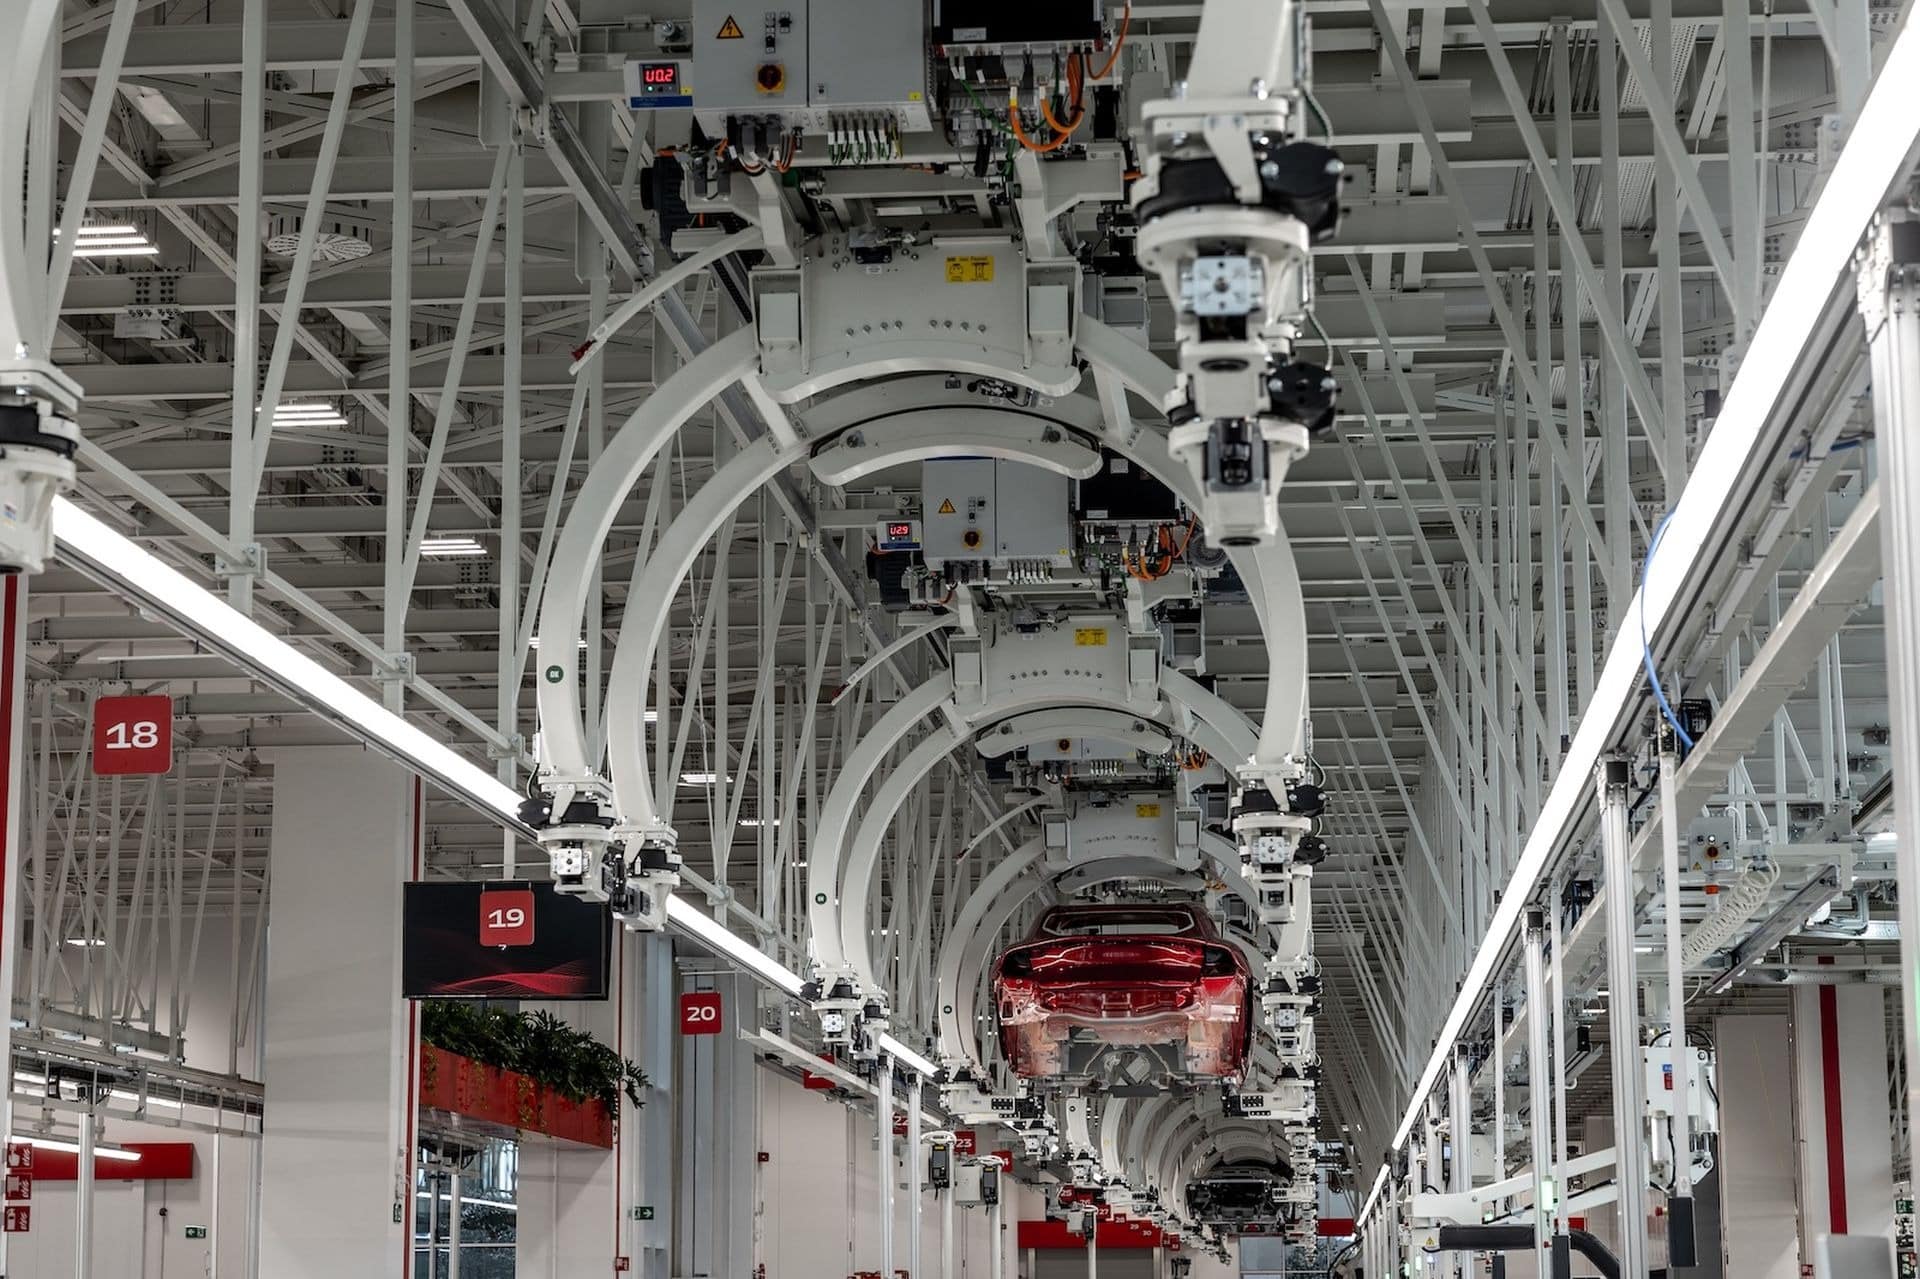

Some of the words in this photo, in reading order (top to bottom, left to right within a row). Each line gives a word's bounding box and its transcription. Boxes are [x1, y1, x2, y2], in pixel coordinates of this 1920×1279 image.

[106, 721, 158, 749] 18
[488, 908, 525, 928] 19
[687, 1006, 716, 1021] 20
[956, 1139, 972, 1148] 23
[1060, 1189, 1072, 1197] 25
